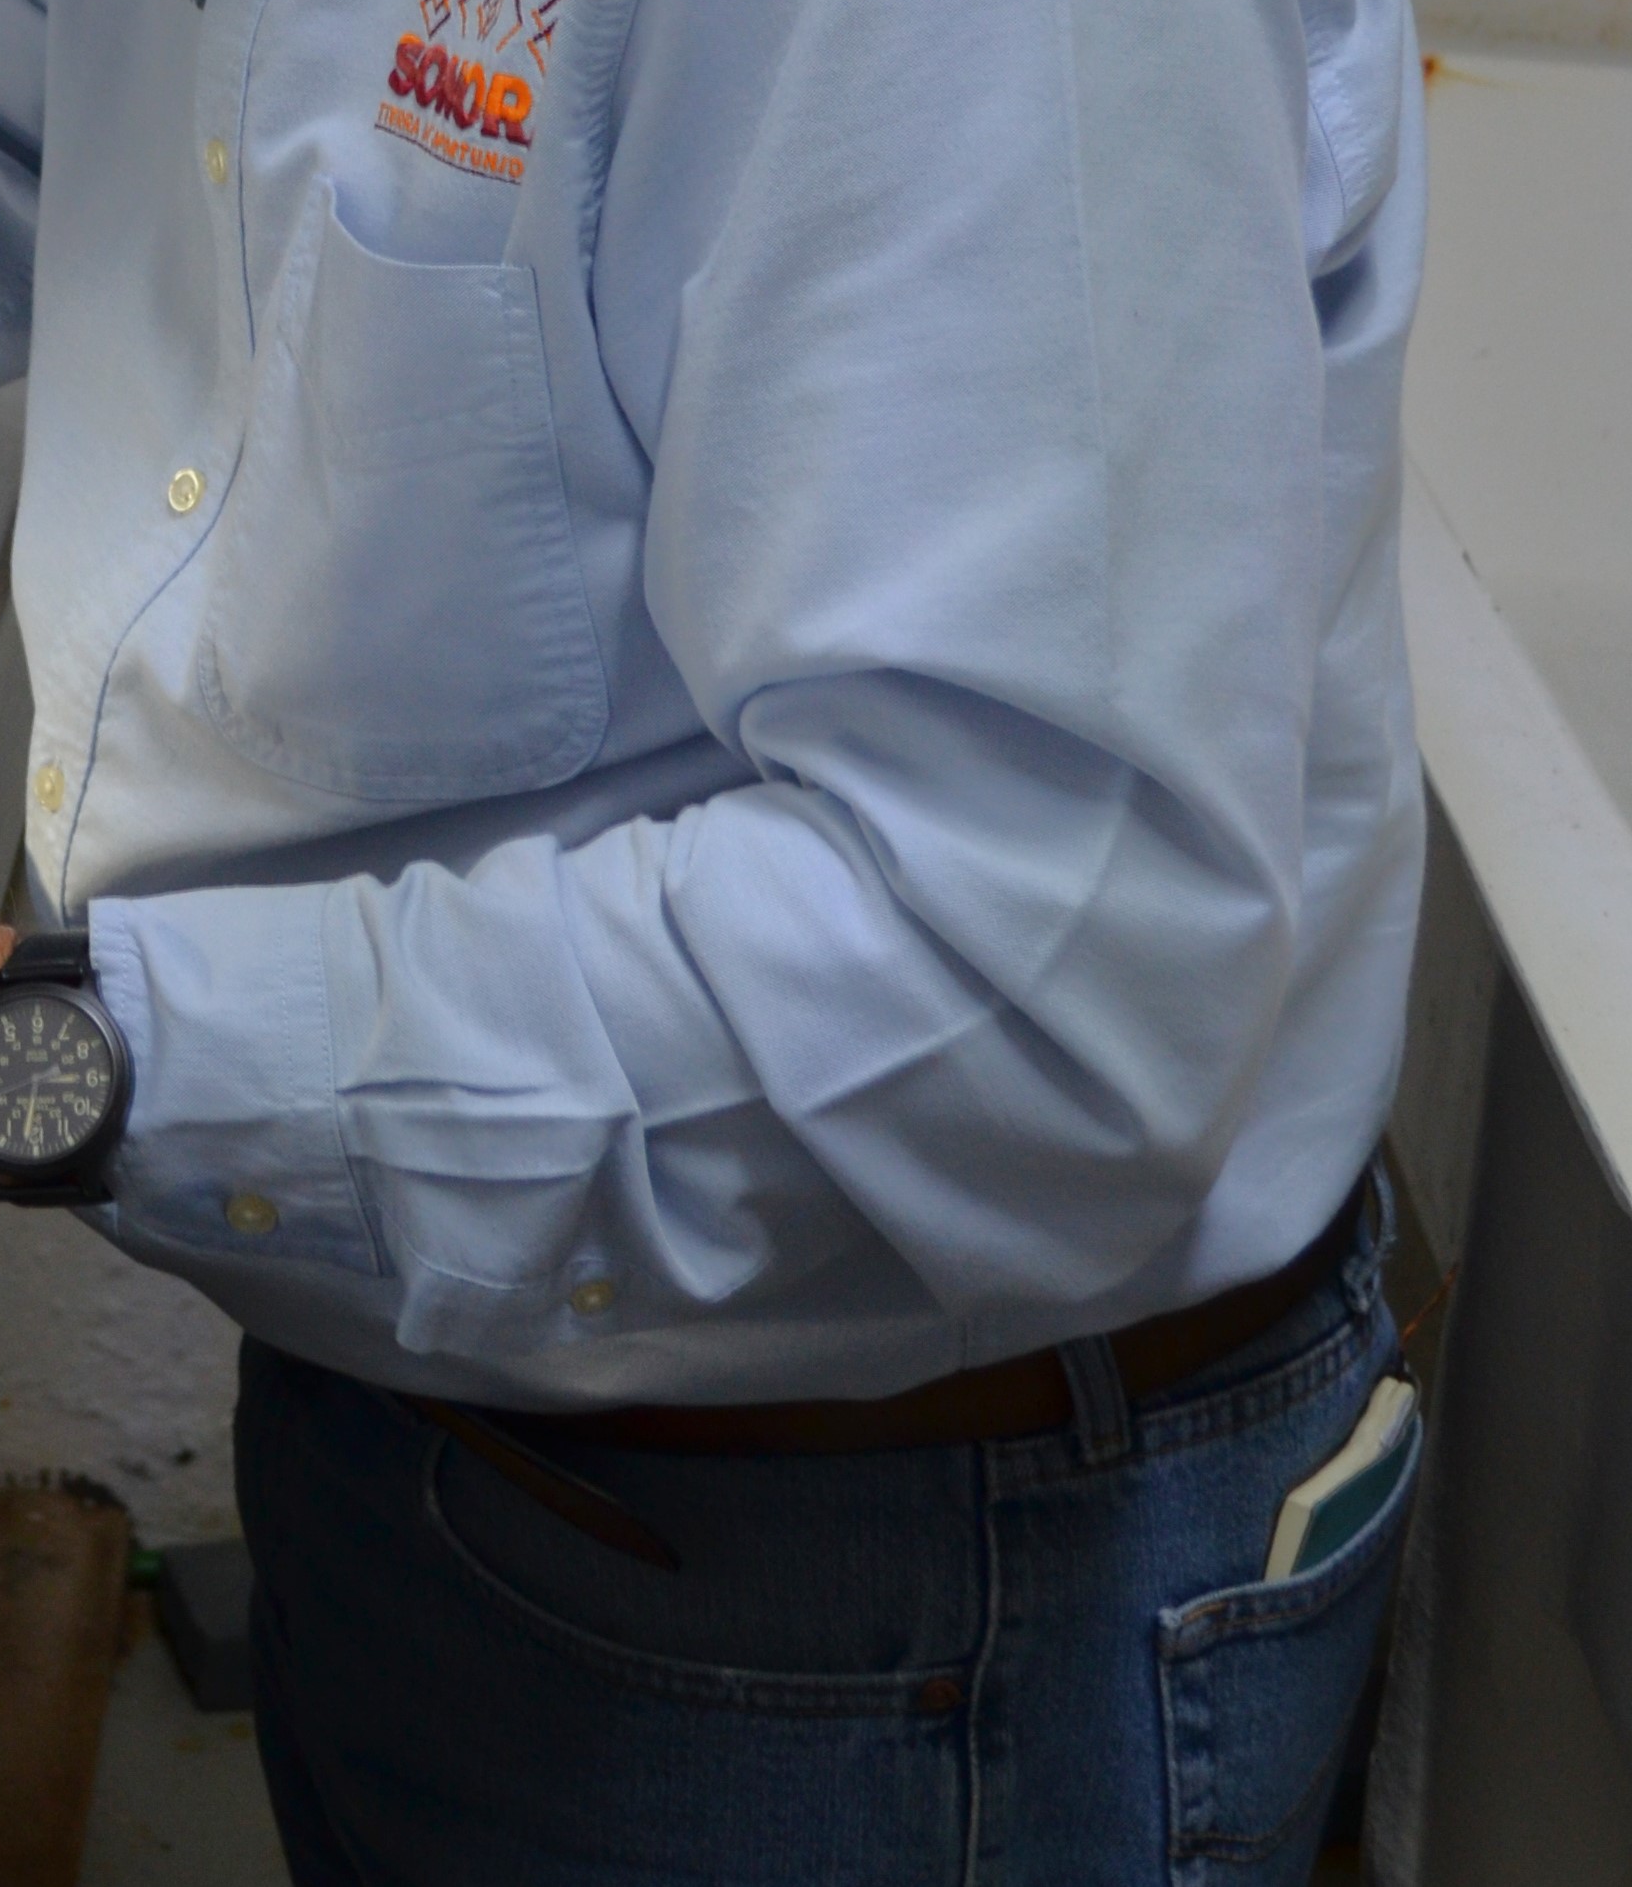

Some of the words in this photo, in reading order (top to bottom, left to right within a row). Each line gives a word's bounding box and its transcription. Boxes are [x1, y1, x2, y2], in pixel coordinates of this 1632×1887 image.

[388, 30, 534, 150] SONOR
[4, 1024, 16, 1042] 5
[32, 1016, 44, 1034] 6
[58, 1023, 70, 1040] 7
[77, 1040, 89, 1059] 8
[86, 1068, 98, 1088] 9
[74, 1097, 90, 1116] 10
